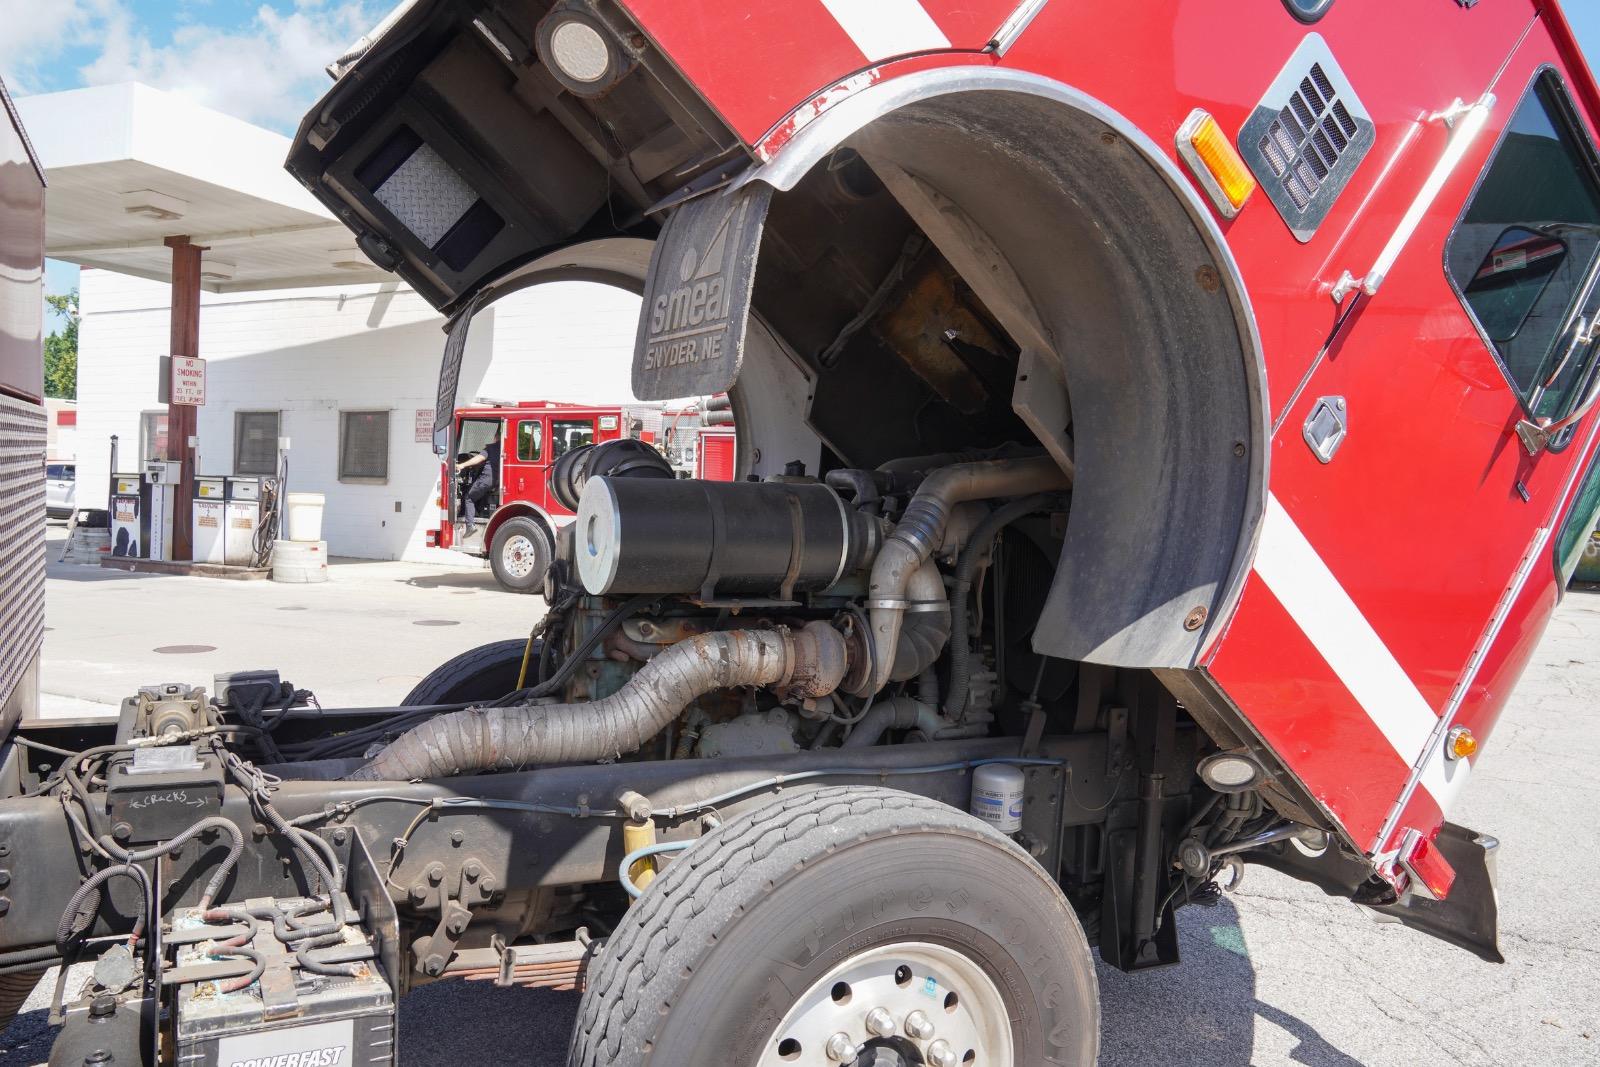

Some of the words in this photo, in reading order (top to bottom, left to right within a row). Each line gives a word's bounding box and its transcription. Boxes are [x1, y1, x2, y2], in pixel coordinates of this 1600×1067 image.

[651, 277, 729, 334] smeal
[185, 359, 194, 368] NO
[644, 339, 699, 370] SNYDER,
[701, 335, 722, 361] NE
[176, 368, 203, 378] SMOKING
